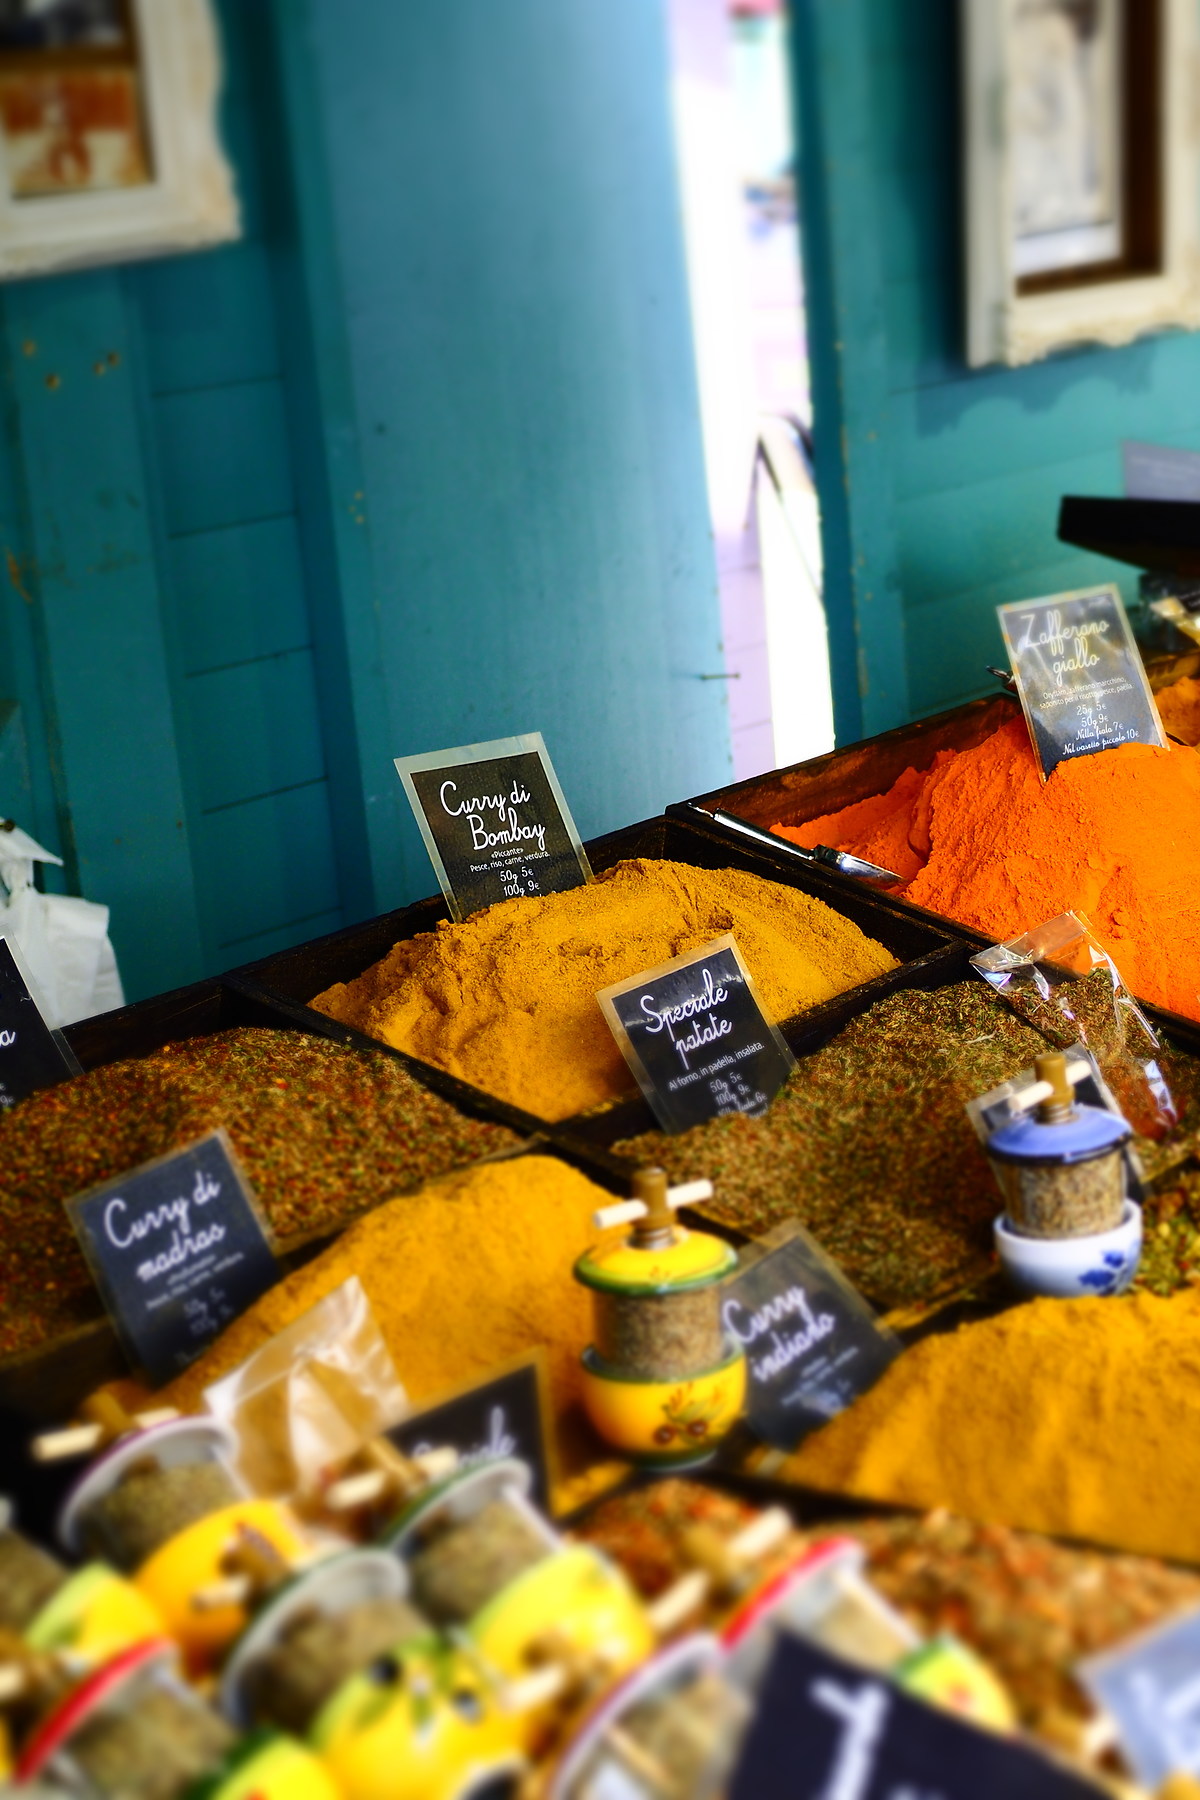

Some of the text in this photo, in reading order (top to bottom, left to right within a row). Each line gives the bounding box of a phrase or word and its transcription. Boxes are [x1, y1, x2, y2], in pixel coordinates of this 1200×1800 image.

[1021, 609, 1109, 656] Zafferano
[1053, 636, 1100, 685] giallo
[1076, 701, 1107, 718] 25g 5€
[1081, 717, 1097, 729] 50g
[1113, 721, 1124, 731] 7€
[1102, 733, 1126, 749] piccolo
[1126, 728, 1140, 739] 10€
[440, 780, 530, 821] Curry di
[466, 807, 546, 851] Bombay
[470, 850, 551, 873] Pesce, riso, carne, verdura.
[500, 866, 534, 884] 50g 5€
[503, 880, 540, 897] 100g 9€
[640, 968, 728, 1042] Speciale
[675, 1013, 733, 1070] patate
[668, 1042, 765, 1092] Al forno, in padella, insalata.
[710, 1072, 743, 1093] 50g 5€
[715, 1091, 738, 1106] 100g
[104, 1169, 221, 1248] Curry di
[137, 1222, 226, 1283] madras
[722, 1286, 814, 1342] Curry
